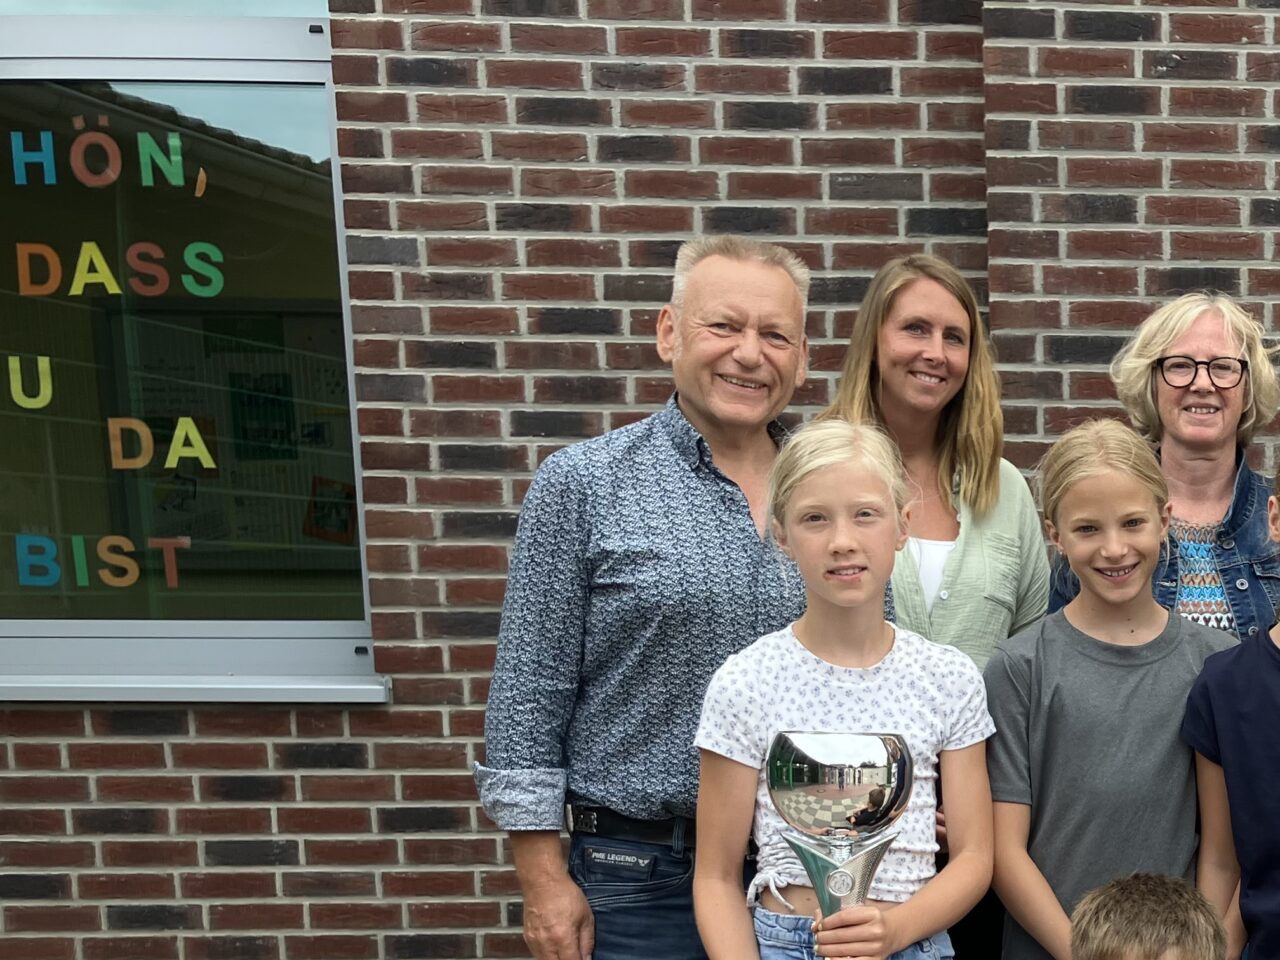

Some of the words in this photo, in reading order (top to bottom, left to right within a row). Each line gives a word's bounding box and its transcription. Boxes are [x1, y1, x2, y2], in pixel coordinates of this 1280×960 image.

[10, 115, 206, 198] HÖN,
[15, 241, 225, 298] DASS
[8, 355, 53, 410] U
[107, 416, 217, 470] DA
[15, 534, 192, 589] BIST
[607, 853, 637, 863] LEGEND
